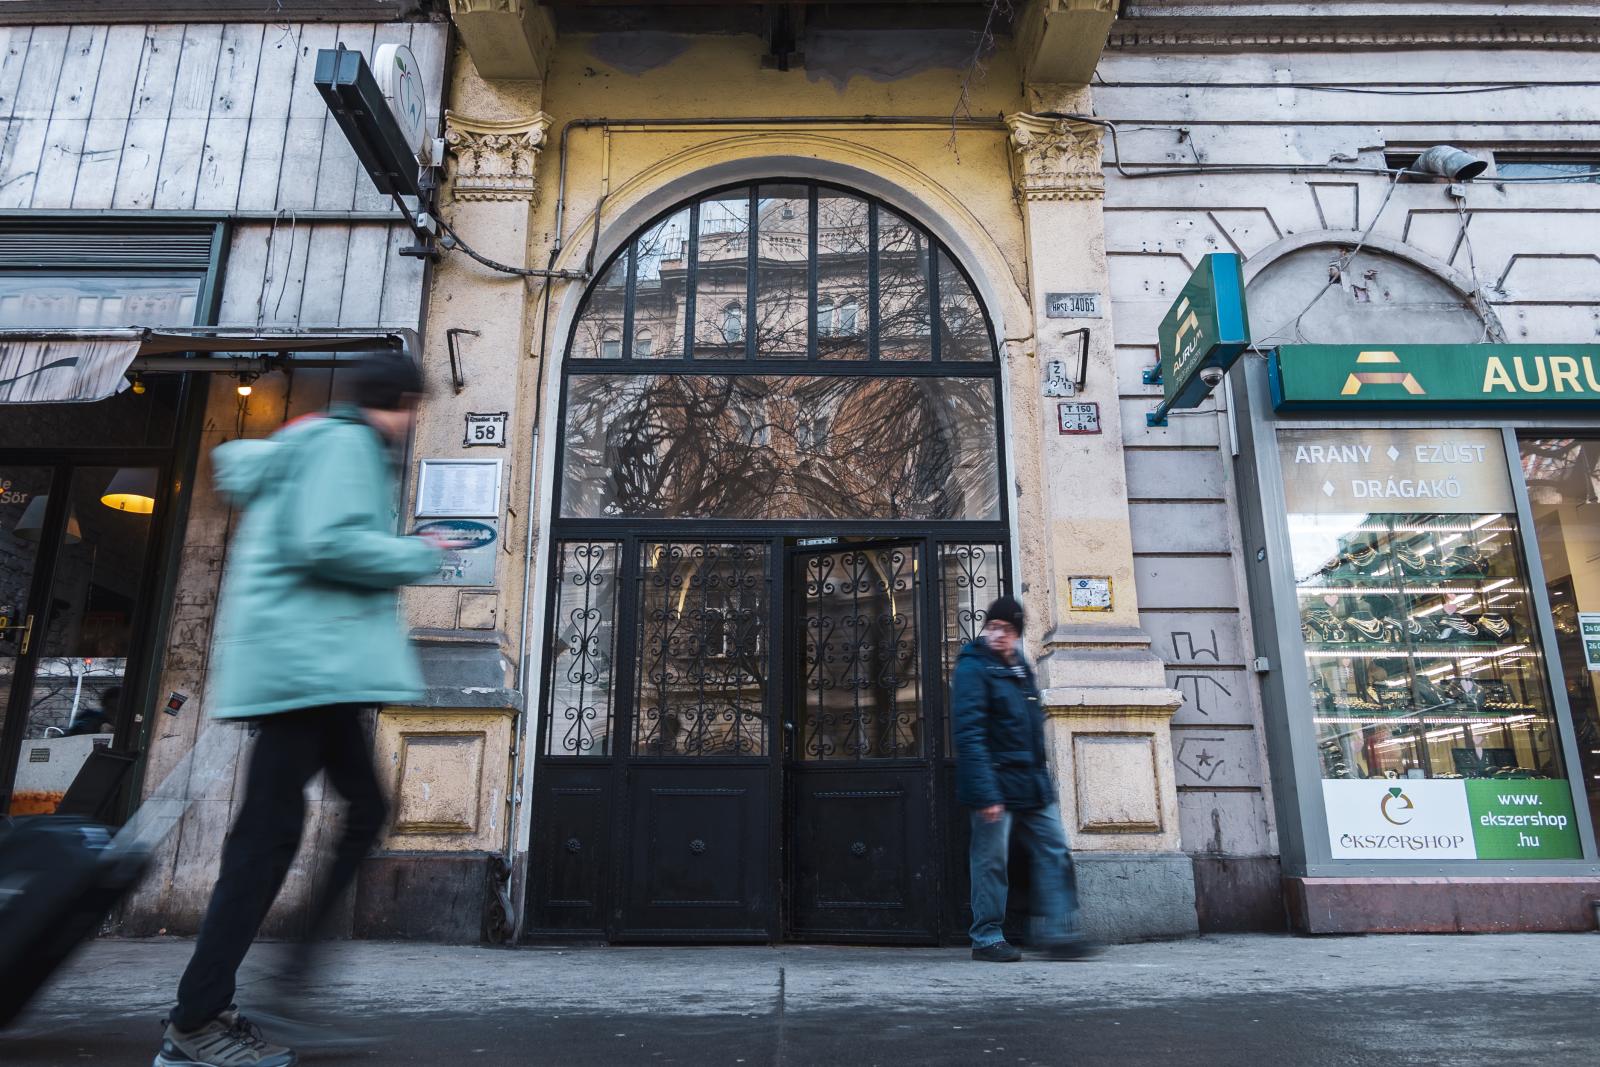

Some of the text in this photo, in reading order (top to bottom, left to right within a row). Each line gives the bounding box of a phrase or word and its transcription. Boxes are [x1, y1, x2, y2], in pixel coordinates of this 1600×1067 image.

[1070, 297, 1095, 312] 34065
[1173, 329, 1204, 376] AURUM
[1066, 405, 1073, 413] T
[475, 425, 495, 440] 58
[1295, 441, 1486, 464] ARANY EZÜST
[1351, 475, 1461, 498] DRÁGAKŐ
[1497, 794, 1543, 805] www.
[1480, 812, 1568, 830] ekszershop
[1516, 832, 1541, 848] .hu
